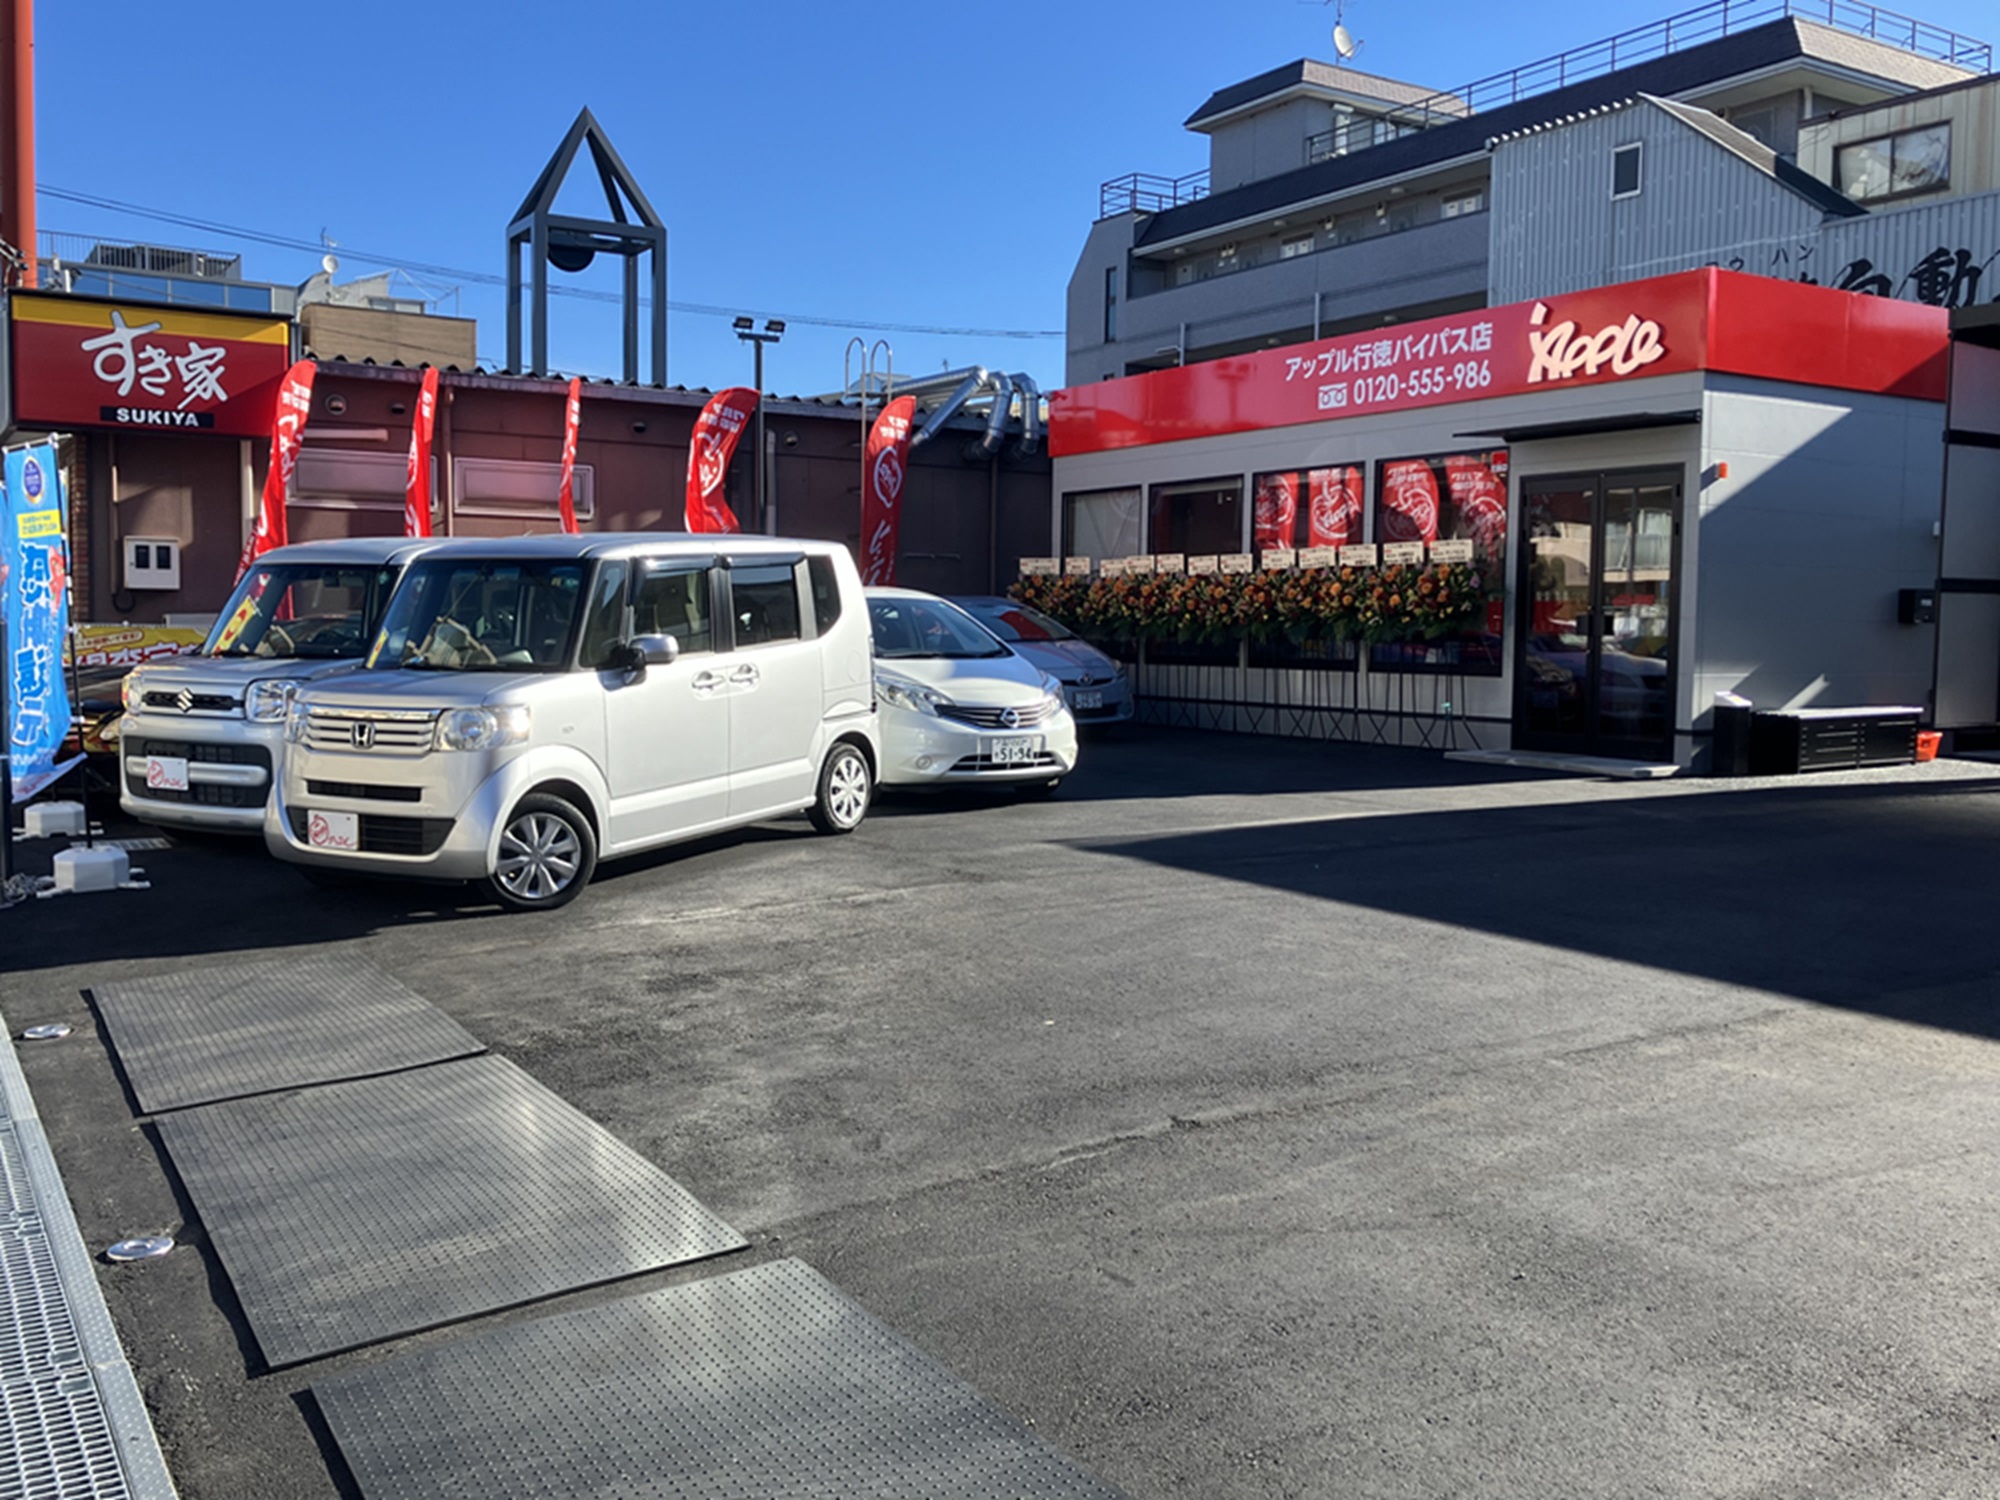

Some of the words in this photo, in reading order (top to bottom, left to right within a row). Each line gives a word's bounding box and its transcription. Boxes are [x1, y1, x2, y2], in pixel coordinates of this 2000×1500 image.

[80, 309, 229, 410] すき家
[1284, 322, 1494, 382] アップル行徳バイパス店
[1353, 360, 1491, 404] 0120-555-986
[116, 407, 200, 427] SUKIYA
